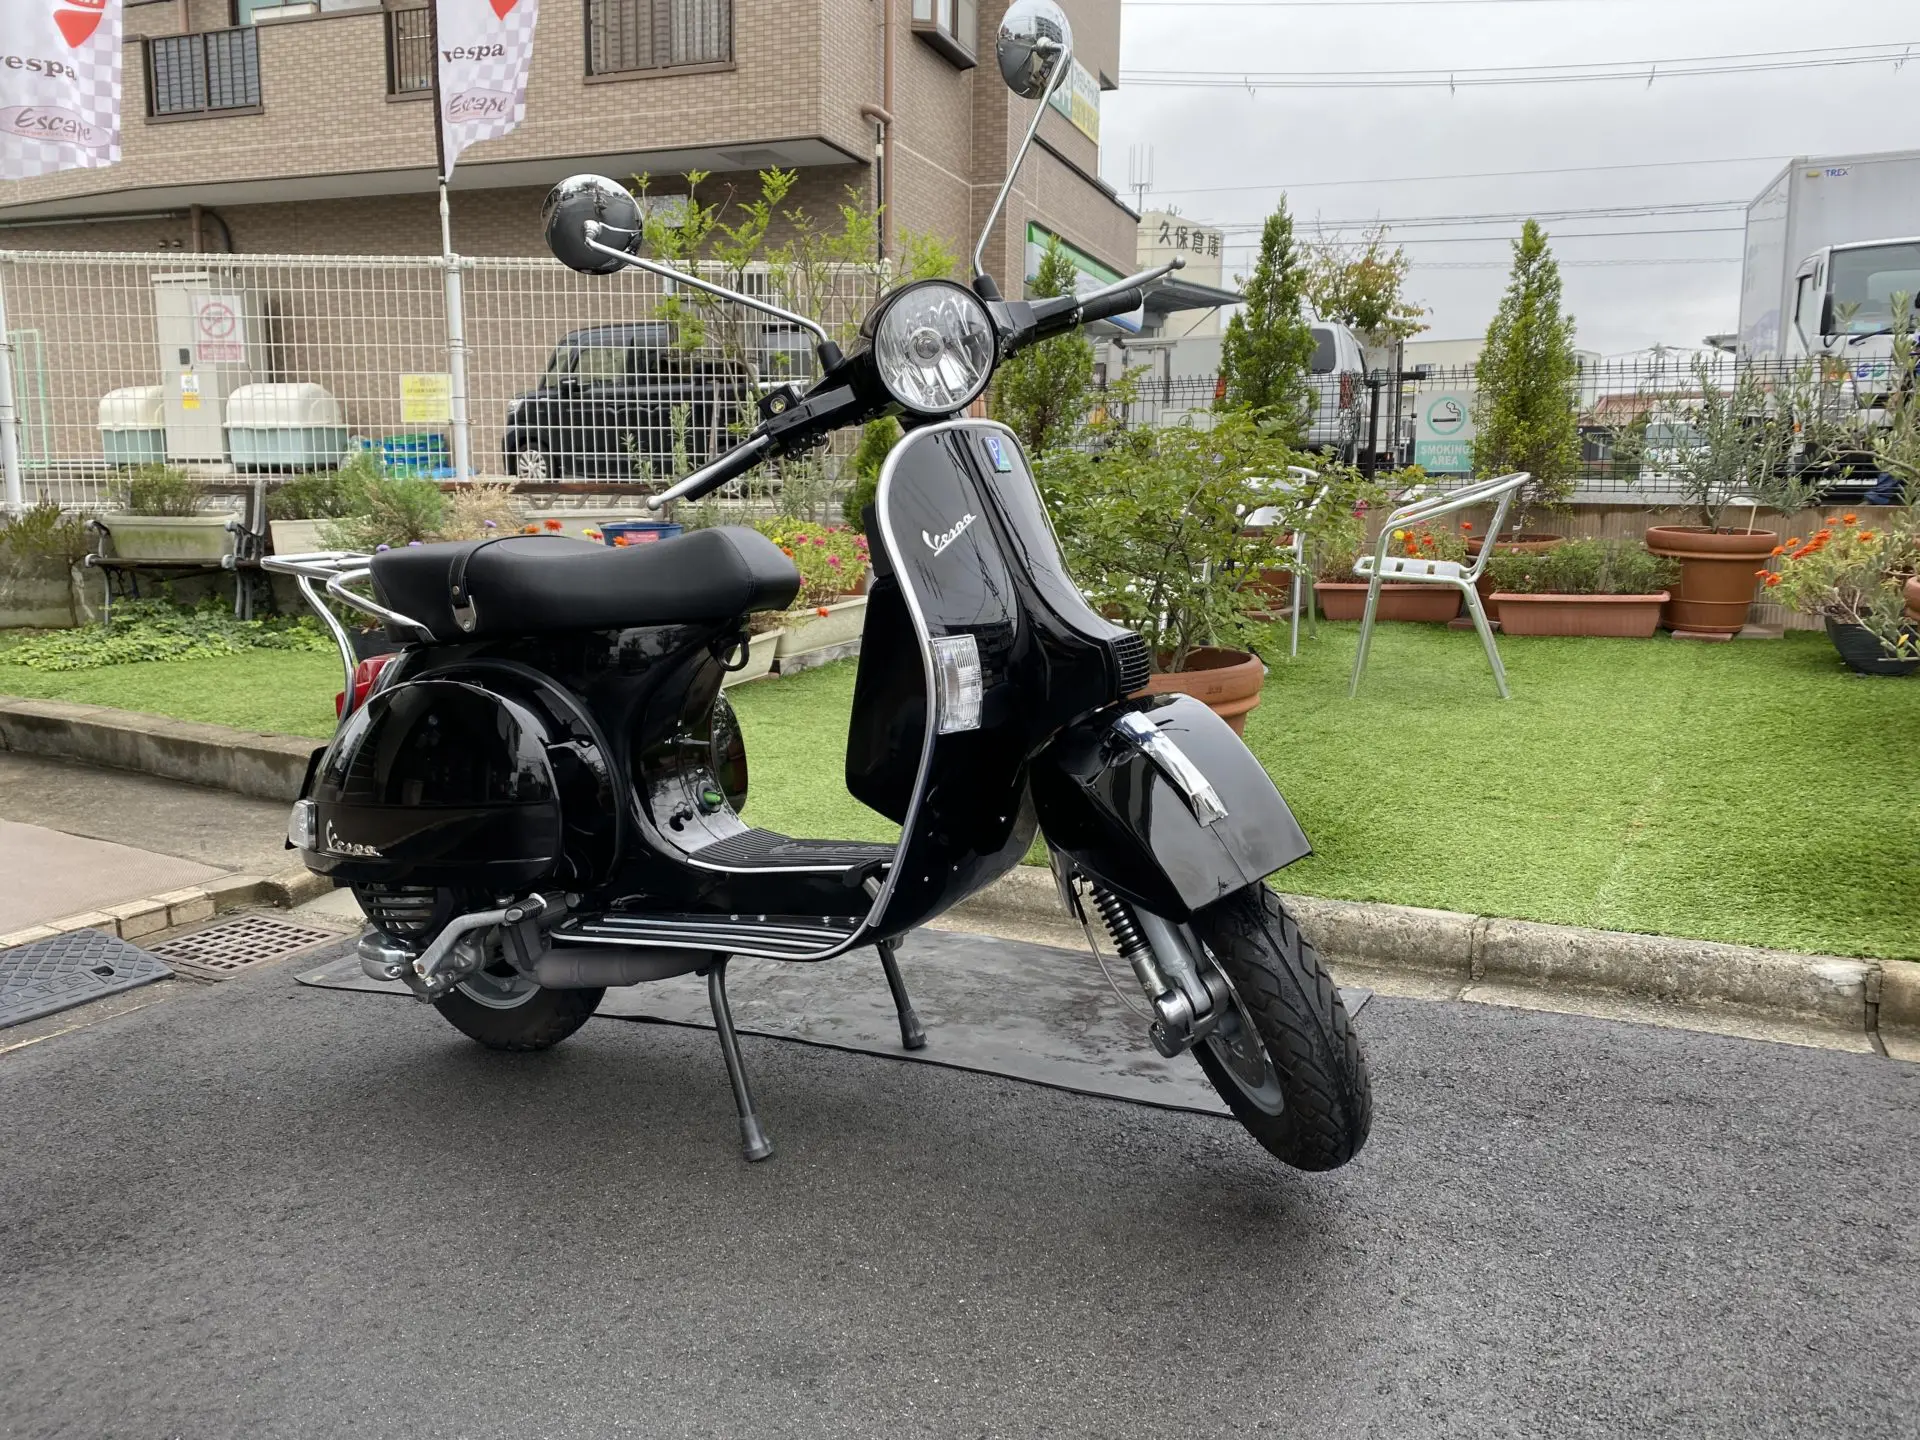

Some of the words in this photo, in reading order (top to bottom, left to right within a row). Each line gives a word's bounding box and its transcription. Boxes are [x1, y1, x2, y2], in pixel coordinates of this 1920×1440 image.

[0, 56, 77, 81] espa
[1158, 220, 1220, 260] 久保倉庫
[1421, 444, 1471, 456] SMOKING
[1430, 456, 1459, 466] AREA
[921, 513, 977, 557] Vespa
[326, 819, 383, 857] Vespa
